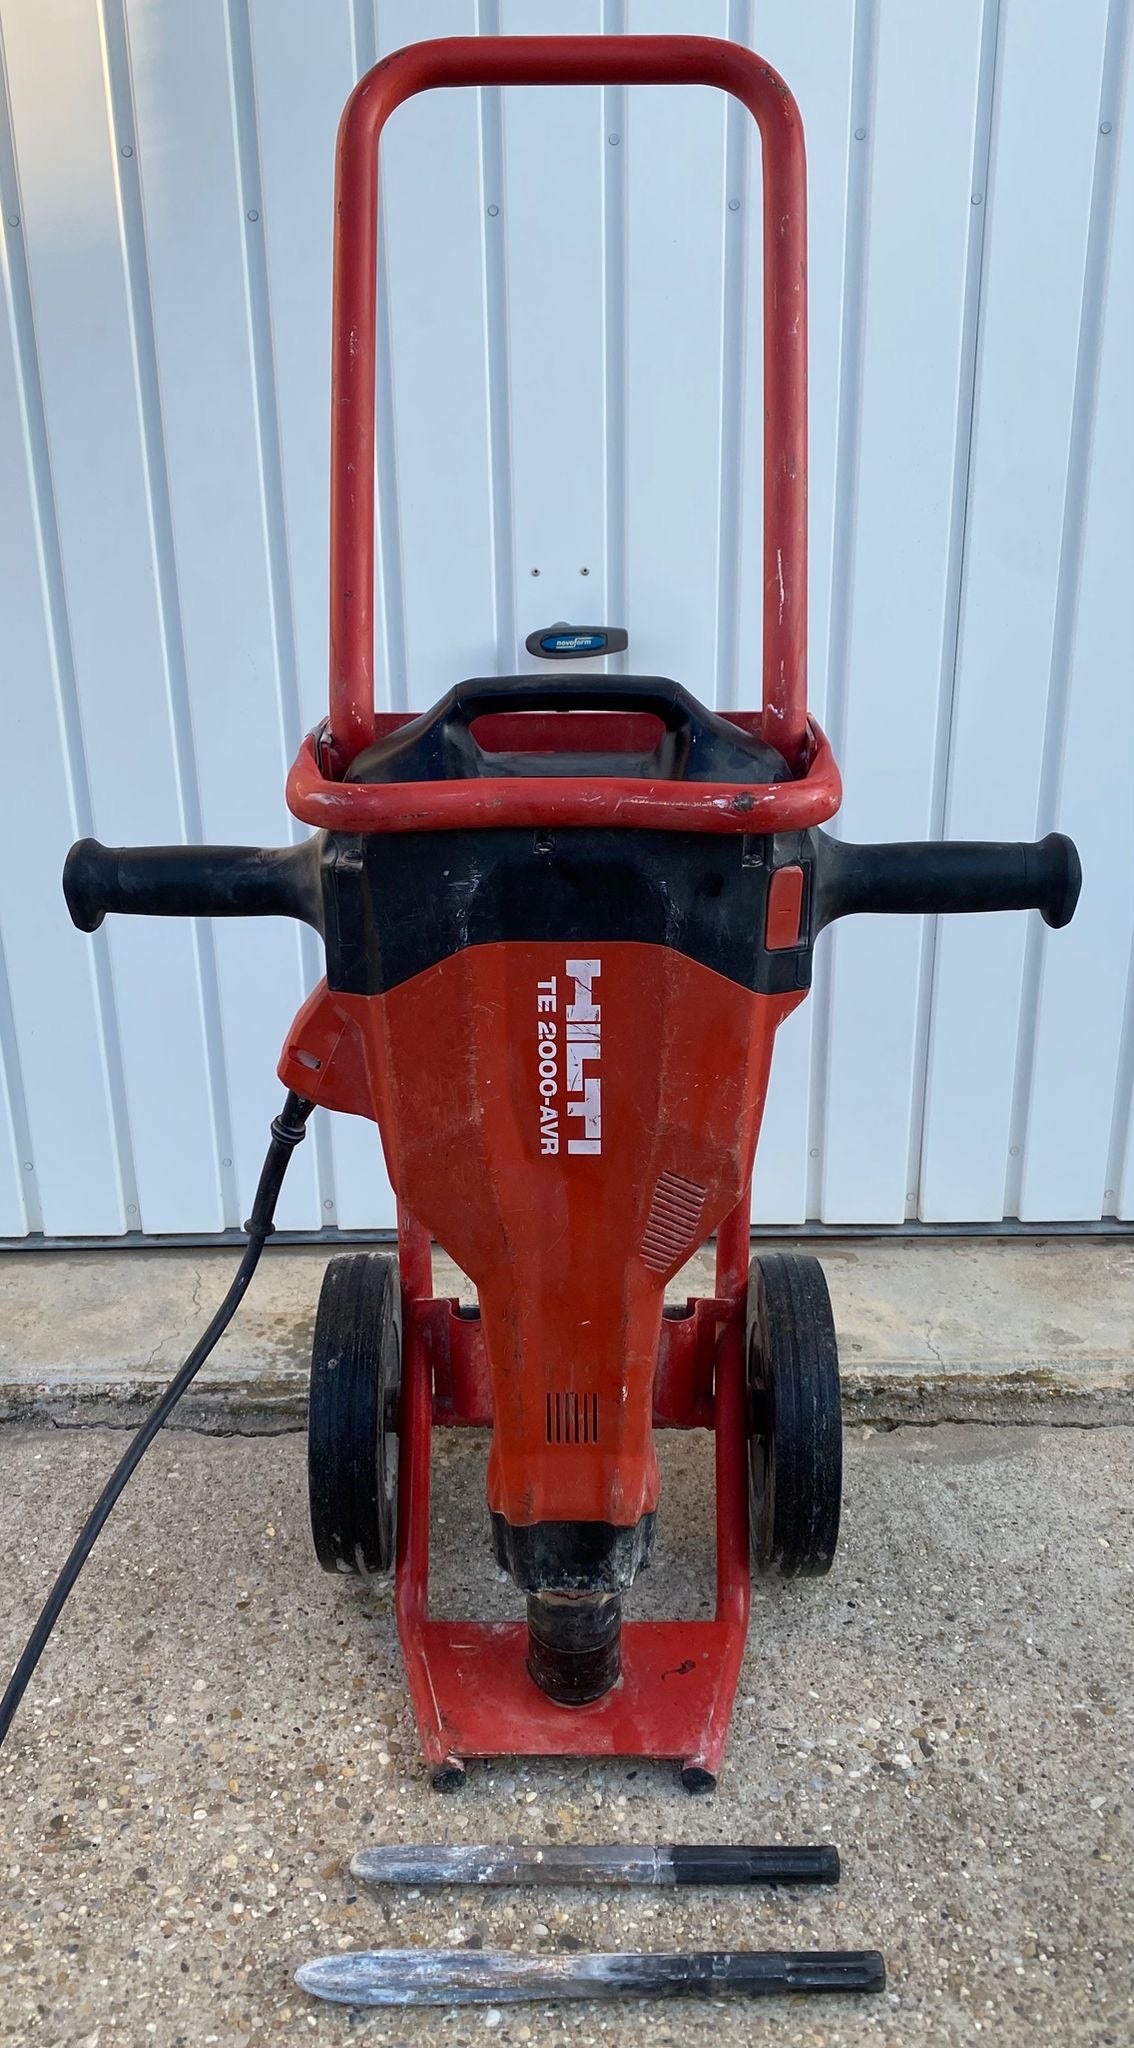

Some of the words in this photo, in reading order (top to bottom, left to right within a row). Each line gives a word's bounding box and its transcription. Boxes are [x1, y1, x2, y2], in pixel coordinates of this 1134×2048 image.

[537, 976, 557, 1013] TE
[566, 959, 601, 1155] HILTI
[537, 1021, 559, 1155] 2000-AVR
